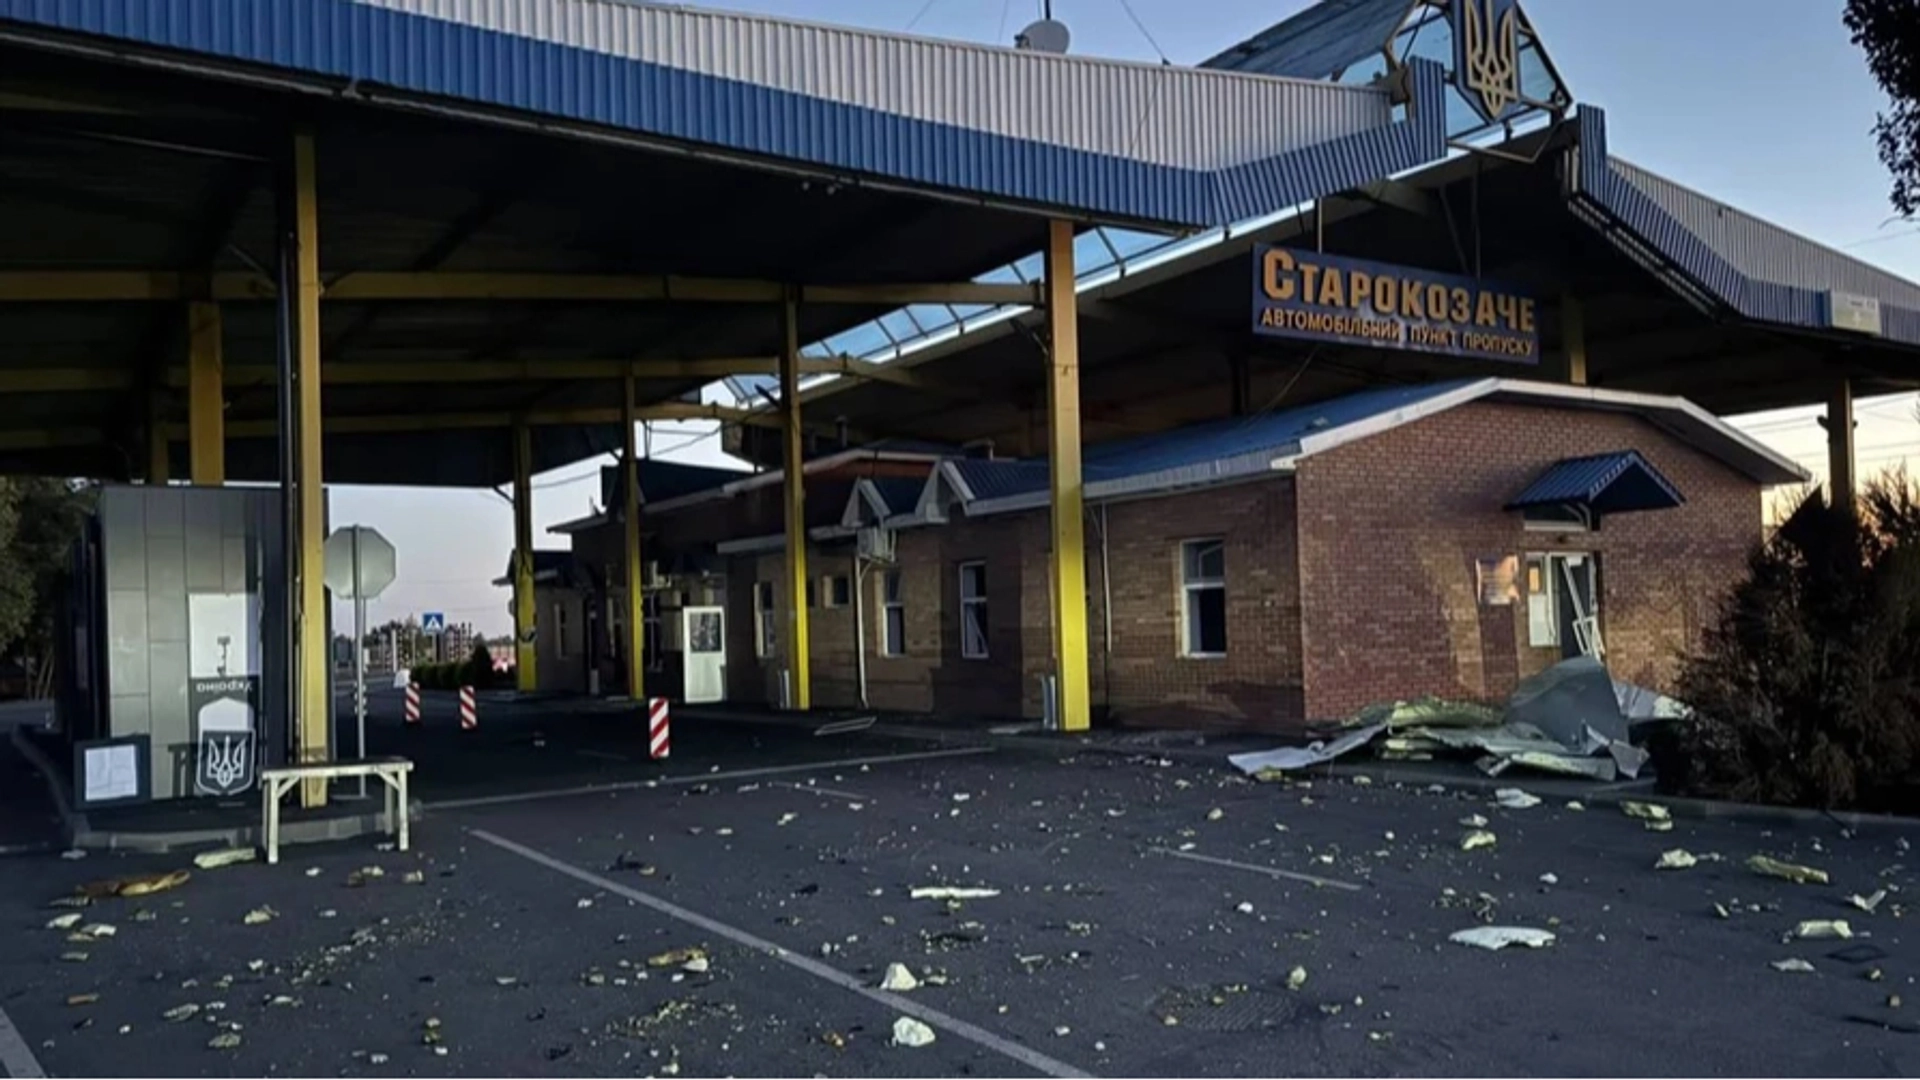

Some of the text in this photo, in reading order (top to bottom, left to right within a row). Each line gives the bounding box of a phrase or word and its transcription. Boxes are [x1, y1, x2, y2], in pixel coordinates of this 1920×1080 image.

[1263, 248, 1536, 332] СТАРОКОЗАЧЕ
[1261, 307, 1533, 356] АВТОМОБІЛЬНИЙ ПУНКТ ПРОПУСКУ
